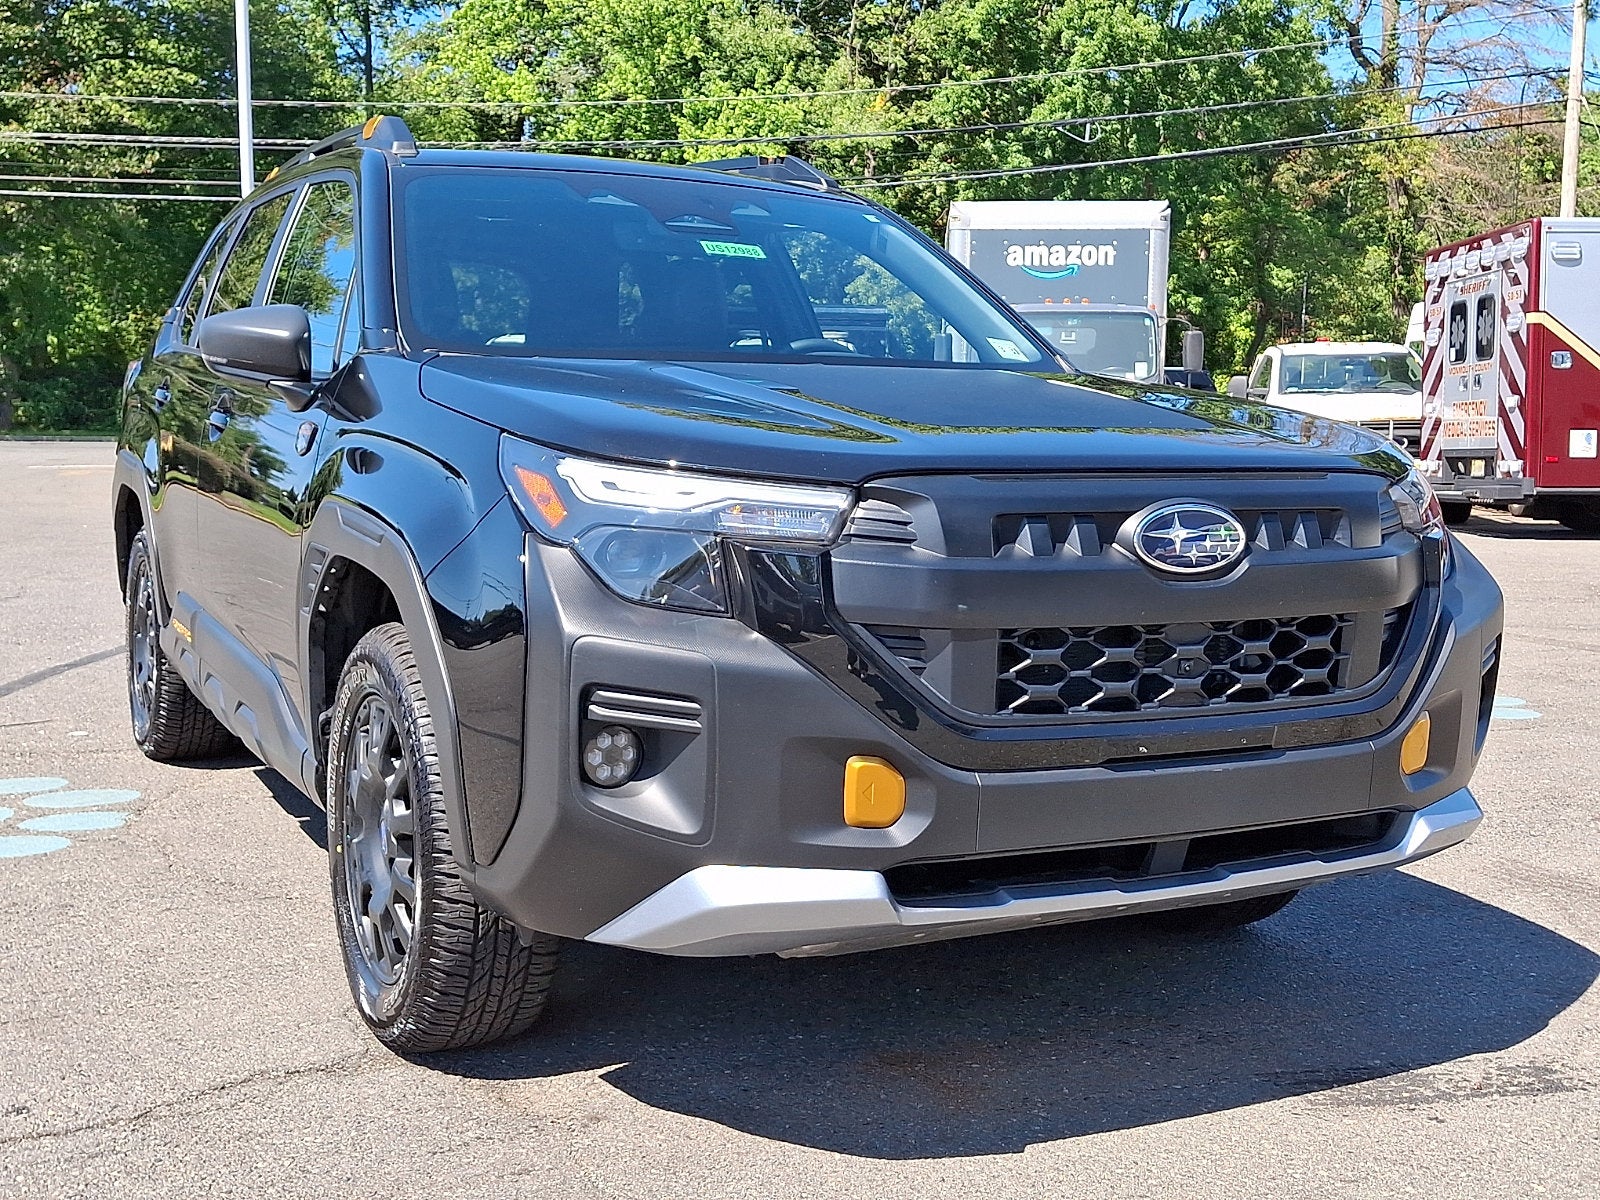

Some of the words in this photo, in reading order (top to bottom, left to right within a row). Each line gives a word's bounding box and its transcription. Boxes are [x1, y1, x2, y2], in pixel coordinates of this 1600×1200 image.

[705, 243, 760, 257] US12988
[1006, 244, 1116, 267] amazon
[1458, 280, 1487, 296] SHERIFF
[1452, 400, 1488, 417] EMERGENCY
[1443, 421, 1468, 438] MEDICAL
[1469, 420, 1496, 437] SERVICES
